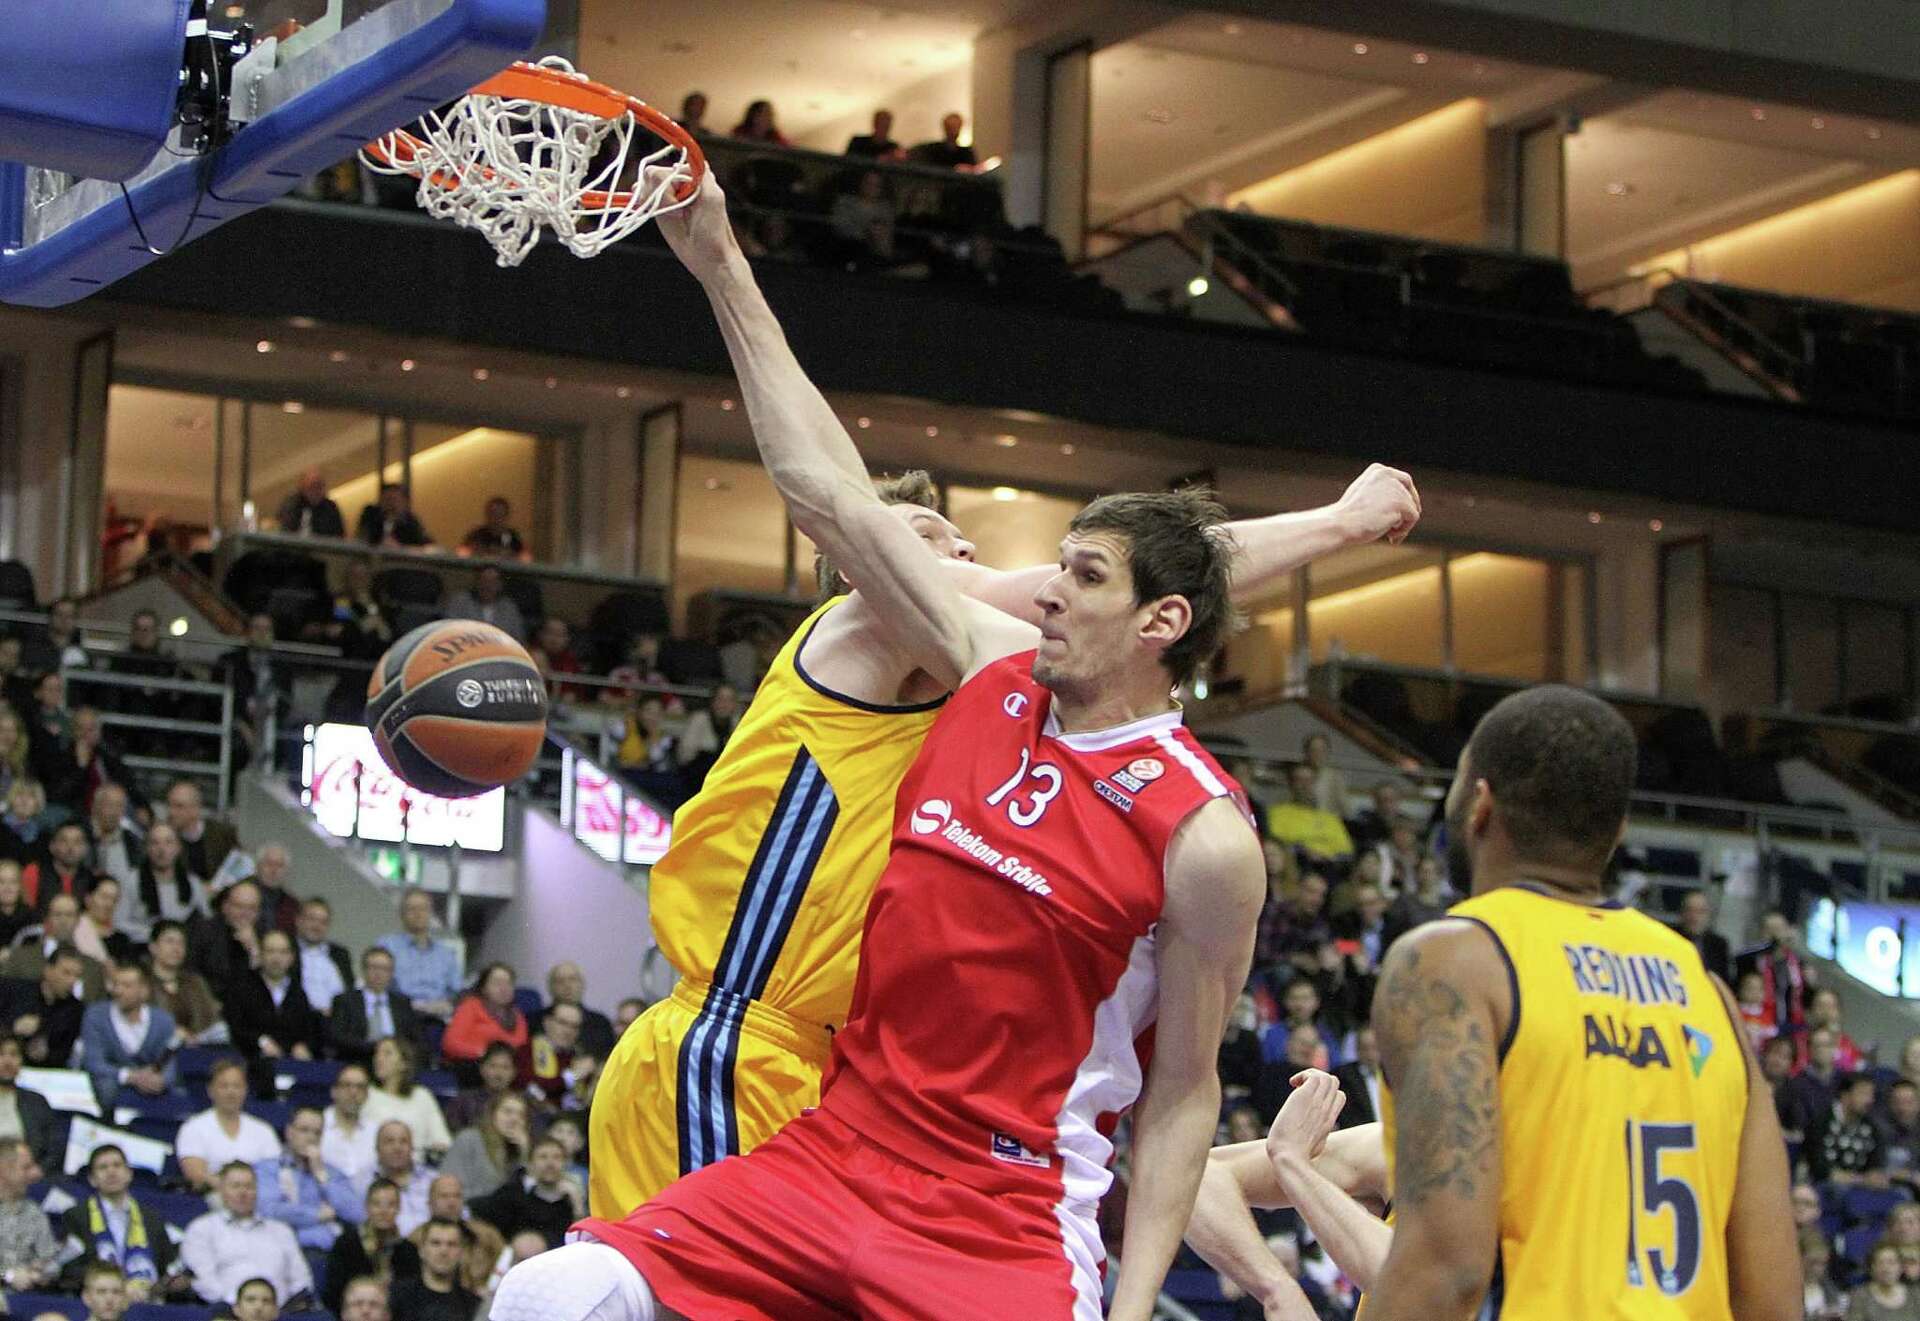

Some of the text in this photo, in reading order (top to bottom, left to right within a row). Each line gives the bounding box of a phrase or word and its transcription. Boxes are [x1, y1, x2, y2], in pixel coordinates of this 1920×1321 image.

[986, 747, 1062, 826] 13
[941, 819, 1052, 896] Telekom Srbija
[1626, 1118, 1699, 1296] 15
